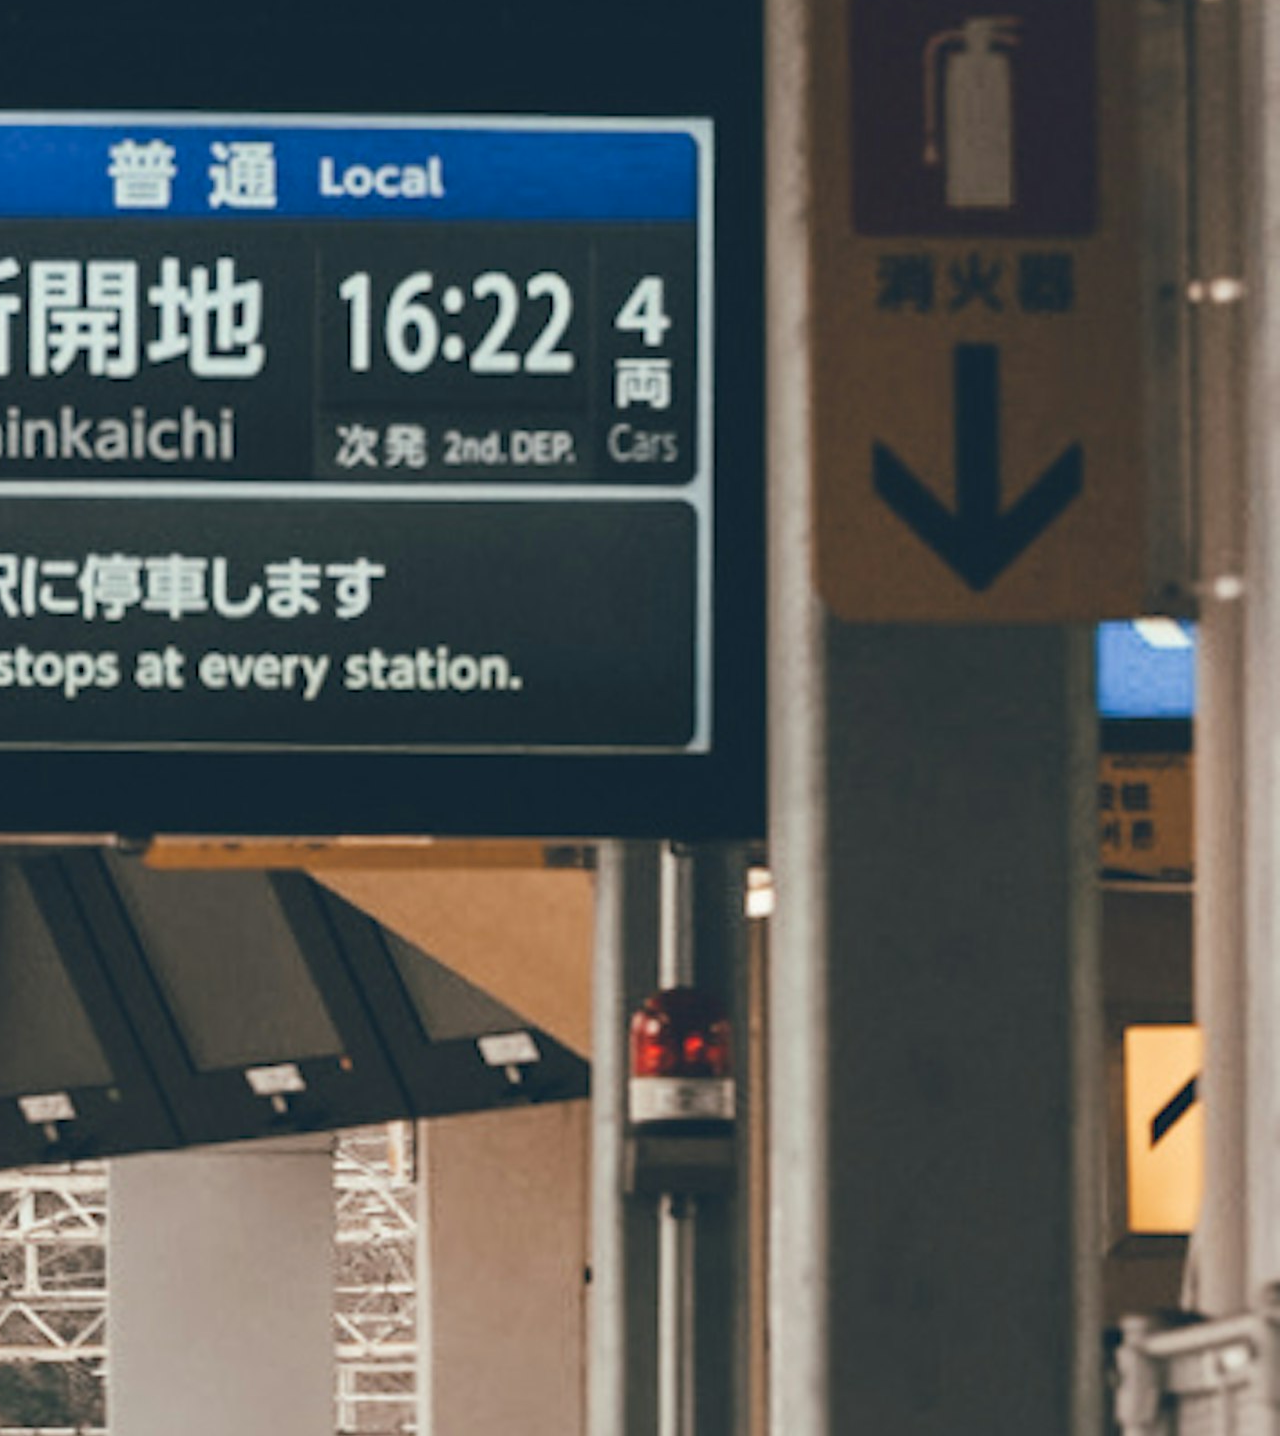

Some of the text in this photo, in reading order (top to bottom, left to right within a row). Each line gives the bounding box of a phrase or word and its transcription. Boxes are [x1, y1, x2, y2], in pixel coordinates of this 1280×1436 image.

[107, 139, 446, 210] 普通 Local
[614, 276, 673, 348] 4
[876, 250, 1076, 314] 消火器
[340, 271, 576, 373] 16:22
[614, 358, 673, 410] 両
[335, 424, 428, 468] 次発
[607, 423, 678, 463] Cars
[135, 648, 185, 689] at
[197, 652, 329, 701] every
[343, 645, 523, 692] station.
